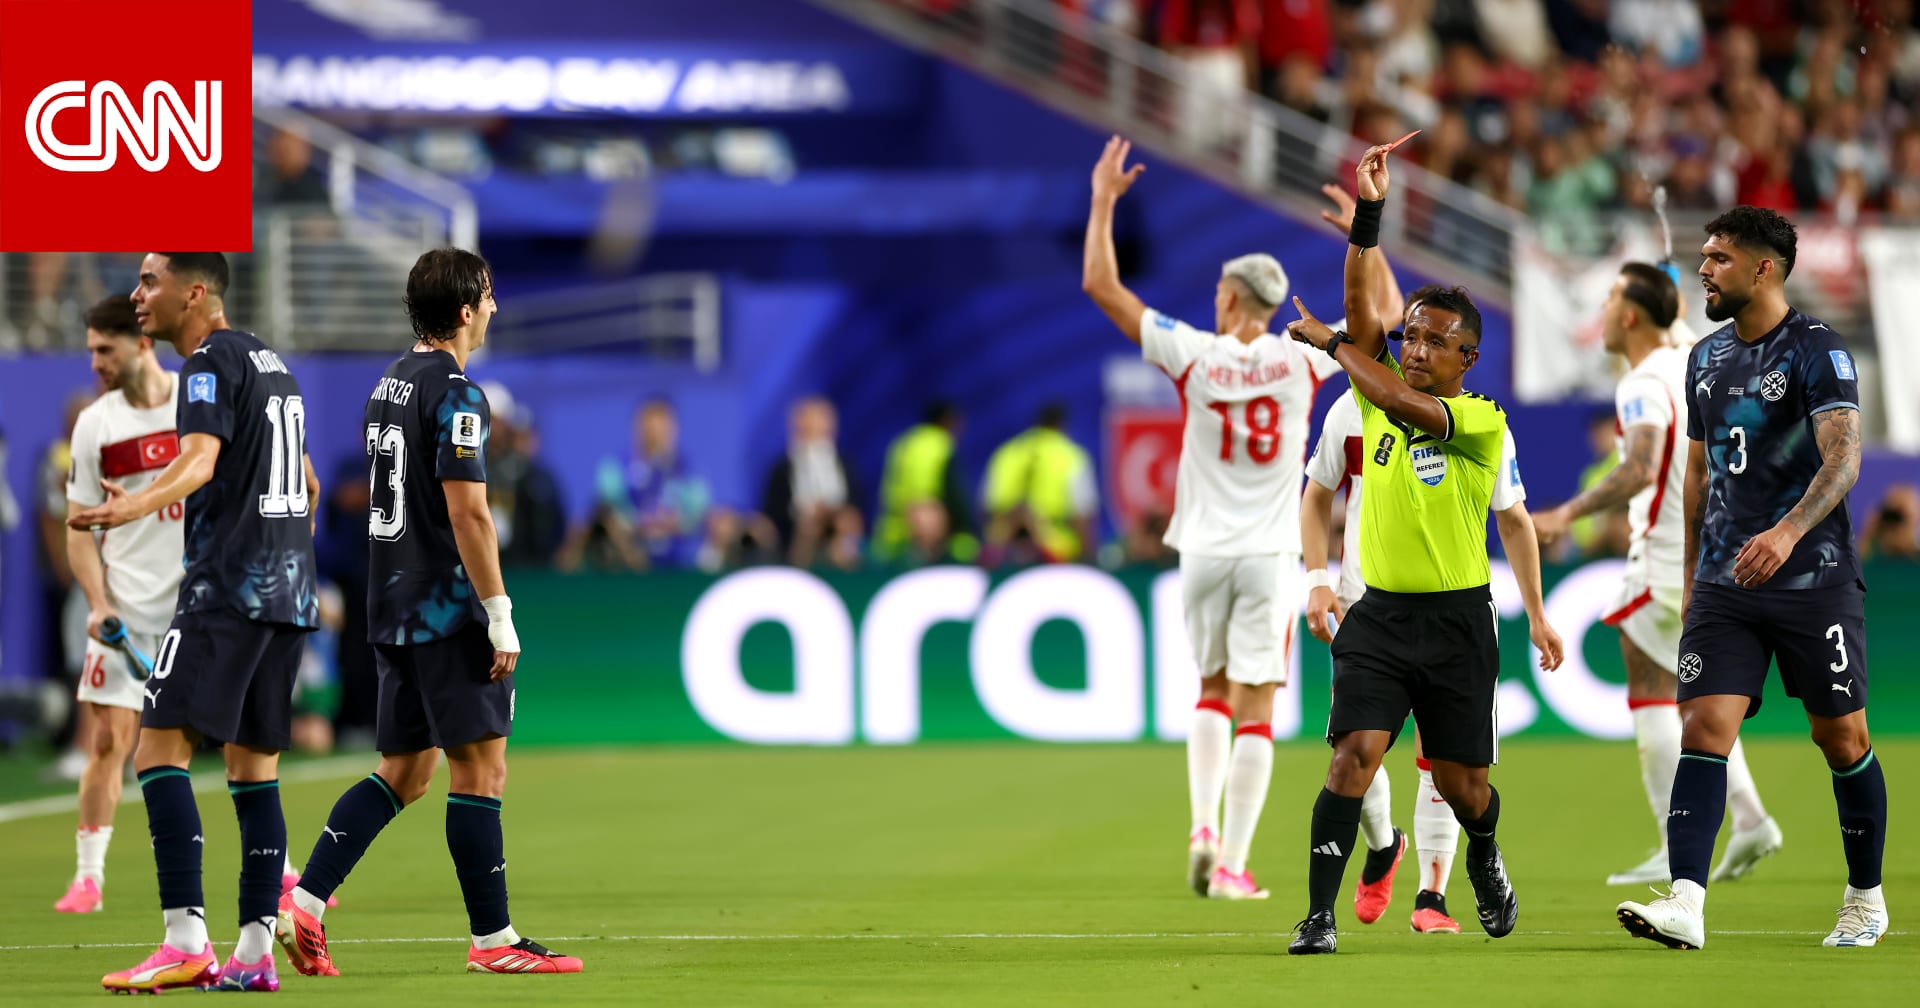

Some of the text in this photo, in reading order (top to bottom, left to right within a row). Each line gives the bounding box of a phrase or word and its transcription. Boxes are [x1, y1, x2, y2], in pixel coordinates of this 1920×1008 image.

[1206, 396, 1282, 466] 18
[1413, 445, 1442, 460] FIFA
[1728, 426, 1748, 475] 3
[259, 395, 309, 518] 10
[1416, 461, 1445, 473] REFEREE
[83, 653, 106, 689] 16
[1825, 623, 1848, 673] 3
